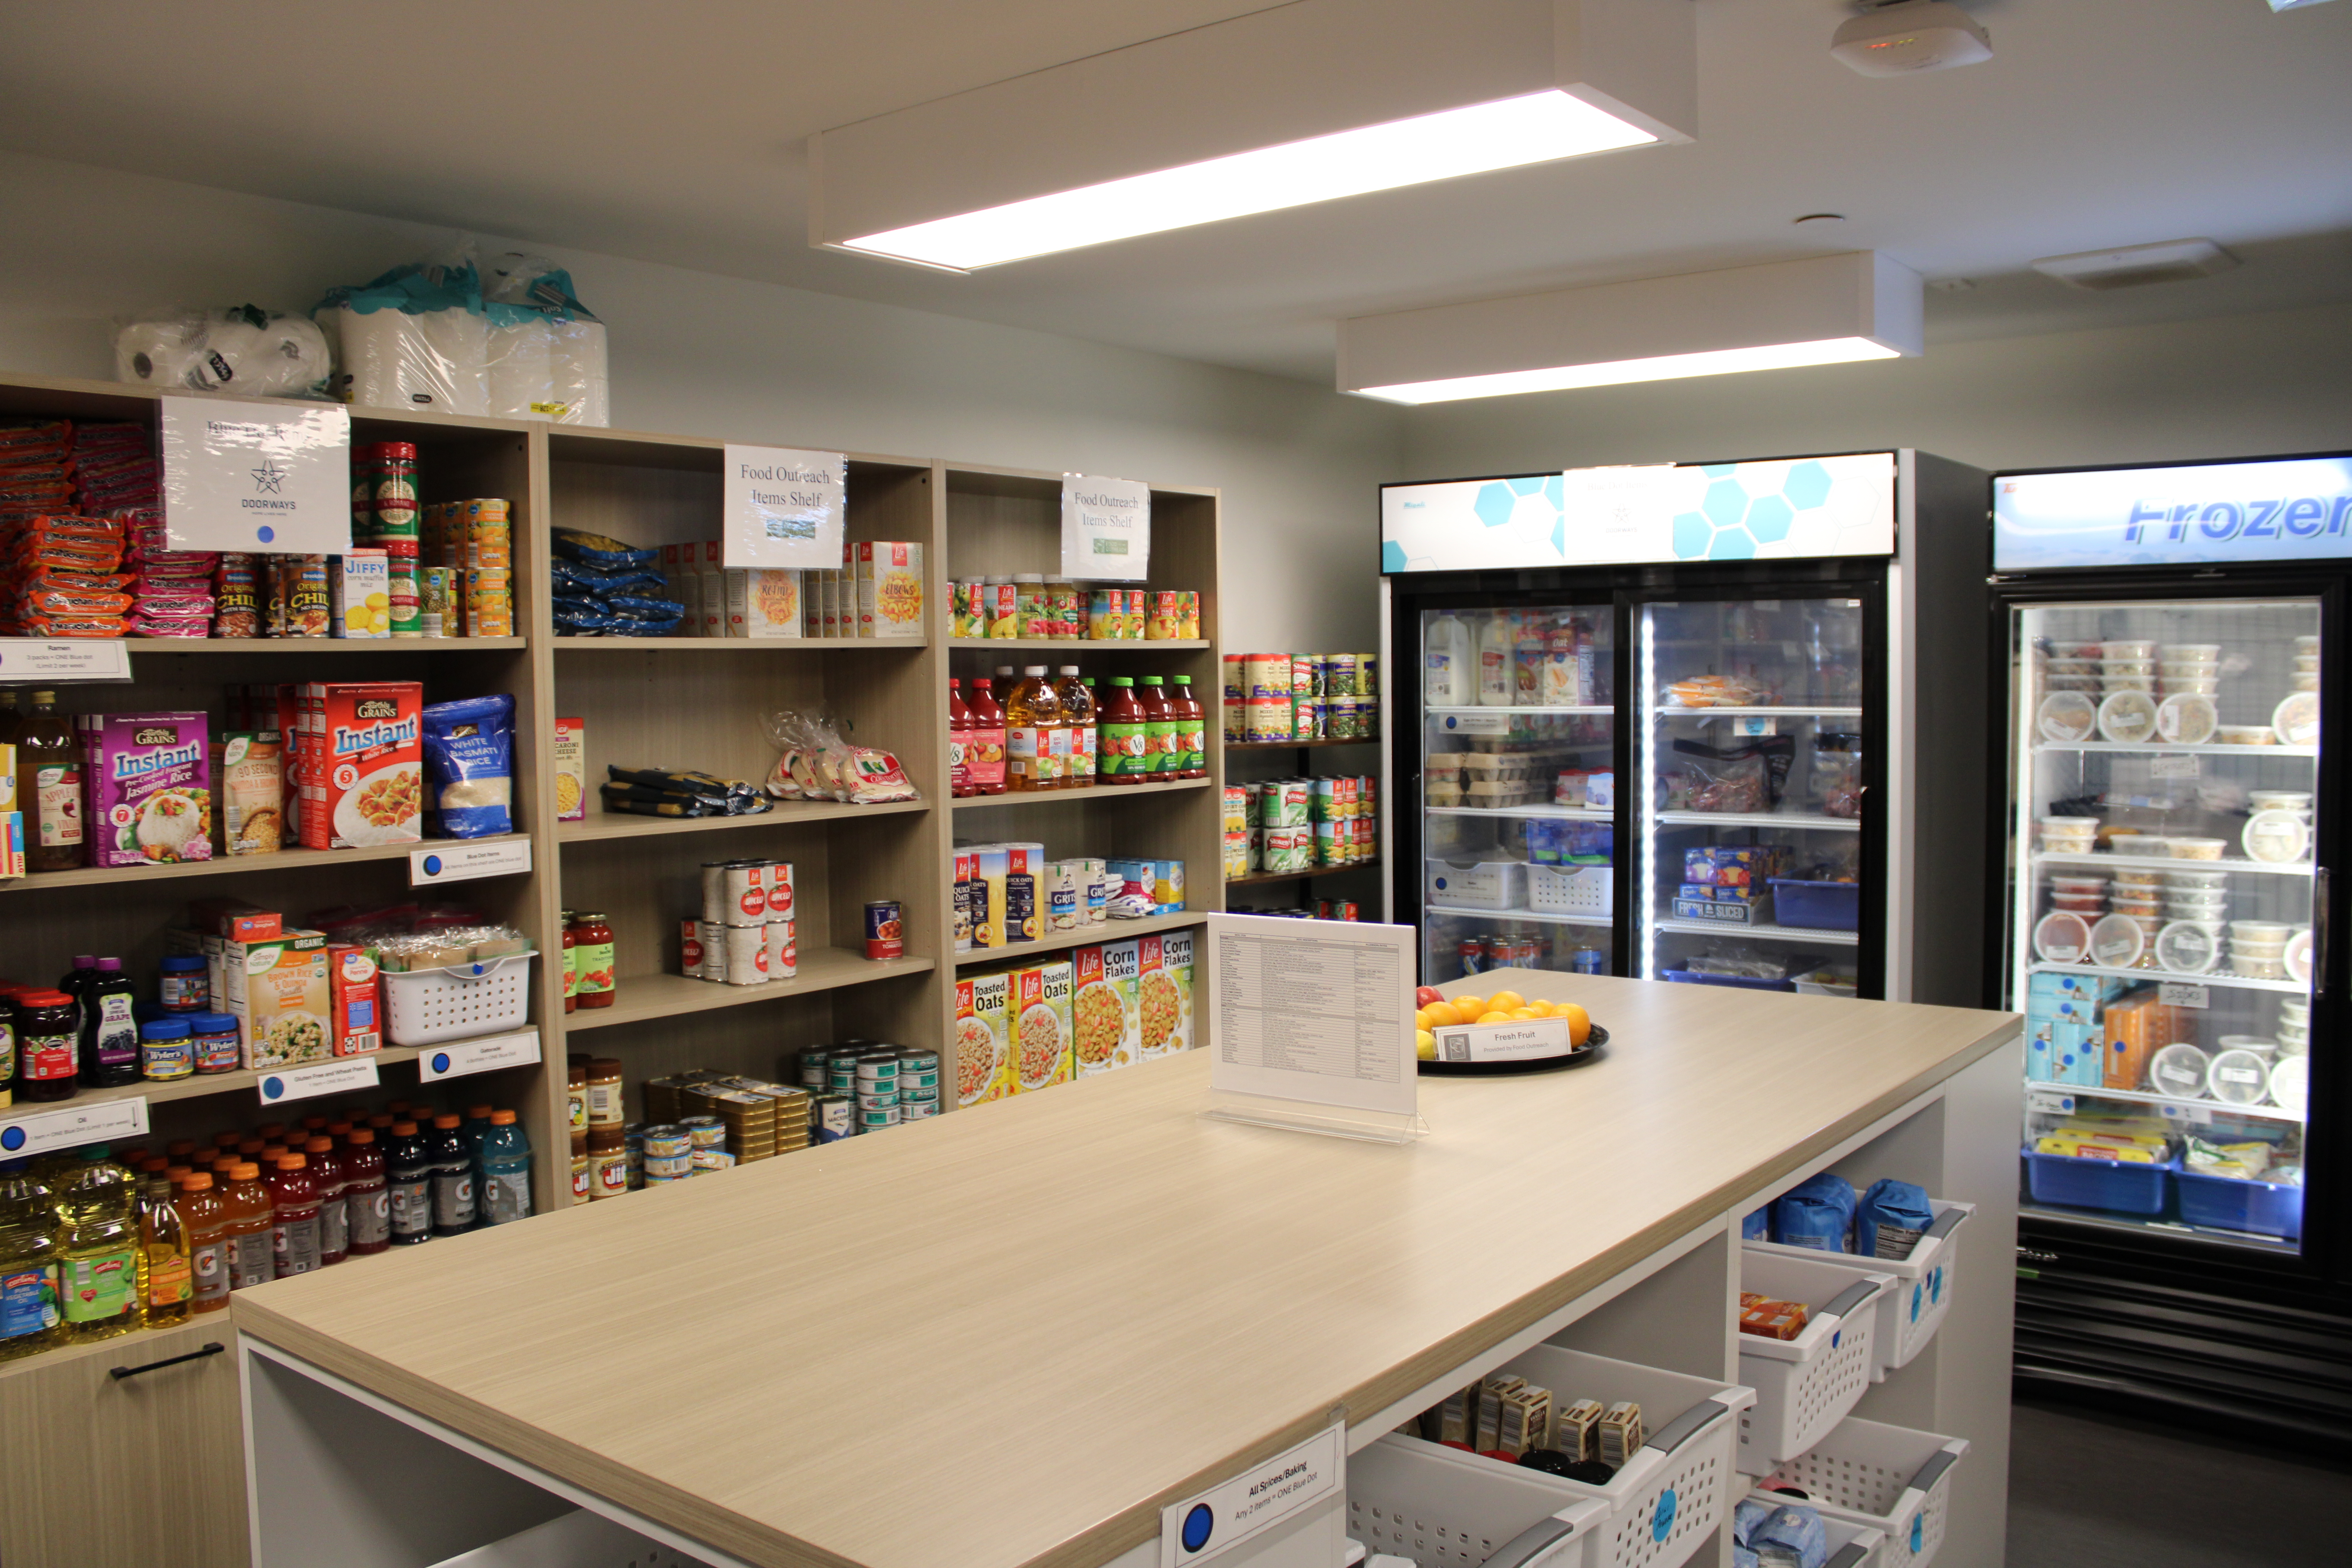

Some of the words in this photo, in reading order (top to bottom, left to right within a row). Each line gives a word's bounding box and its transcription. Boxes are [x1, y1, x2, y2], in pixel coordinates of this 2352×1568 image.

[740, 464, 773, 479] Food
[777, 466, 830, 483] Outreach
[1587, 482, 1606, 490] Blue
[1608, 481, 1624, 490] Dot
[1626, 480, 1648, 489] Items
[752, 489, 786, 505] Items
[790, 492, 822, 506] Shelf
[1074, 492, 1097, 506] Food
[1100, 494, 1139, 509] Outreach
[242, 499, 296, 510] DOORWAYS
[1082, 514, 1107, 527] Items
[1109, 515, 1133, 528] Shelf
[2125, 495, 2352, 544] Frozen
[895, 546, 904, 559] Life
[345, 560, 386, 573] JIFFY
[885, 584, 914, 595] ELBOWS
[1002, 588, 1011, 598] Life
[1134, 592, 1143, 603] Life
[1162, 594, 1172, 604] Life
[1552, 637, 1568, 648] Oat
[358, 704, 396, 719] GRAINS
[136, 733, 177, 744] GRAINS
[335, 717, 416, 753] Instant
[1073, 734, 1082, 744] Life
[450, 738, 487, 749] WHITE
[1038, 737, 1048, 747] Life
[1133, 737, 1143, 753] V8
[450, 748, 498, 757] BASMATI
[116, 744, 198, 777] Instant
[238, 766, 250, 777] 90
[251, 764, 278, 775] SECOND
[343, 772, 350, 780] 5
[125, 769, 165, 788] Pre-Cooked
[125, 779, 167, 801] Jasmine
[169, 771, 192, 784] Rice
[119, 811, 125, 820] 7
[958, 863, 967, 875] Life
[1013, 858, 1023, 867] Life
[954, 886, 970, 895] QUICK
[1090, 886, 1105, 897] GRI
[1716, 906, 1744, 920] SLICED
[294, 937, 324, 949] ORGANIC
[1163, 938, 1191, 954] Corn
[253, 953, 274, 962] Simply
[1104, 949, 1135, 965] Corn
[1143, 942, 1159, 964] Life
[1082, 953, 1099, 977] Life
[1164, 953, 1191, 967] Flakes
[267, 970, 294, 983] BROWN
[296, 968, 312, 978] RICE
[1042, 969, 1069, 985] Toasted
[1105, 965, 1135, 979] Flakes
[282, 979, 307, 988] QUINOA
[974, 983, 1005, 997] Toasted
[1025, 977, 1039, 1000] Life
[1044, 983, 1068, 999] Oats
[975, 995, 1004, 1012] Oats
[1495, 1032, 1516, 1042] Fresh
[1518, 1031, 1536, 1040] Fruit
[209, 1041, 236, 1051] Wyler's
[149, 1050, 181, 1060] Wyler's
[294, 1074, 312, 1083] Gluten
[334, 1069, 351, 1077] Wheat
[352, 1065, 367, 1074] Pasta
[605, 1164, 626, 1186] Jif
[1879, 1224, 1904, 1234] Nutrition
[1249, 1484, 1259, 1498] All
[1259, 1461, 1307, 1490] Spices/Baking
[1235, 1507, 1249, 1521] Any
[1249, 1504, 1254, 1514] 2
[1254, 1496, 1271, 1511] items
[1277, 1486, 1292, 1499] ONE
[1293, 1479, 1306, 1493] Blue
[1307, 1471, 1318, 1485] Dot
